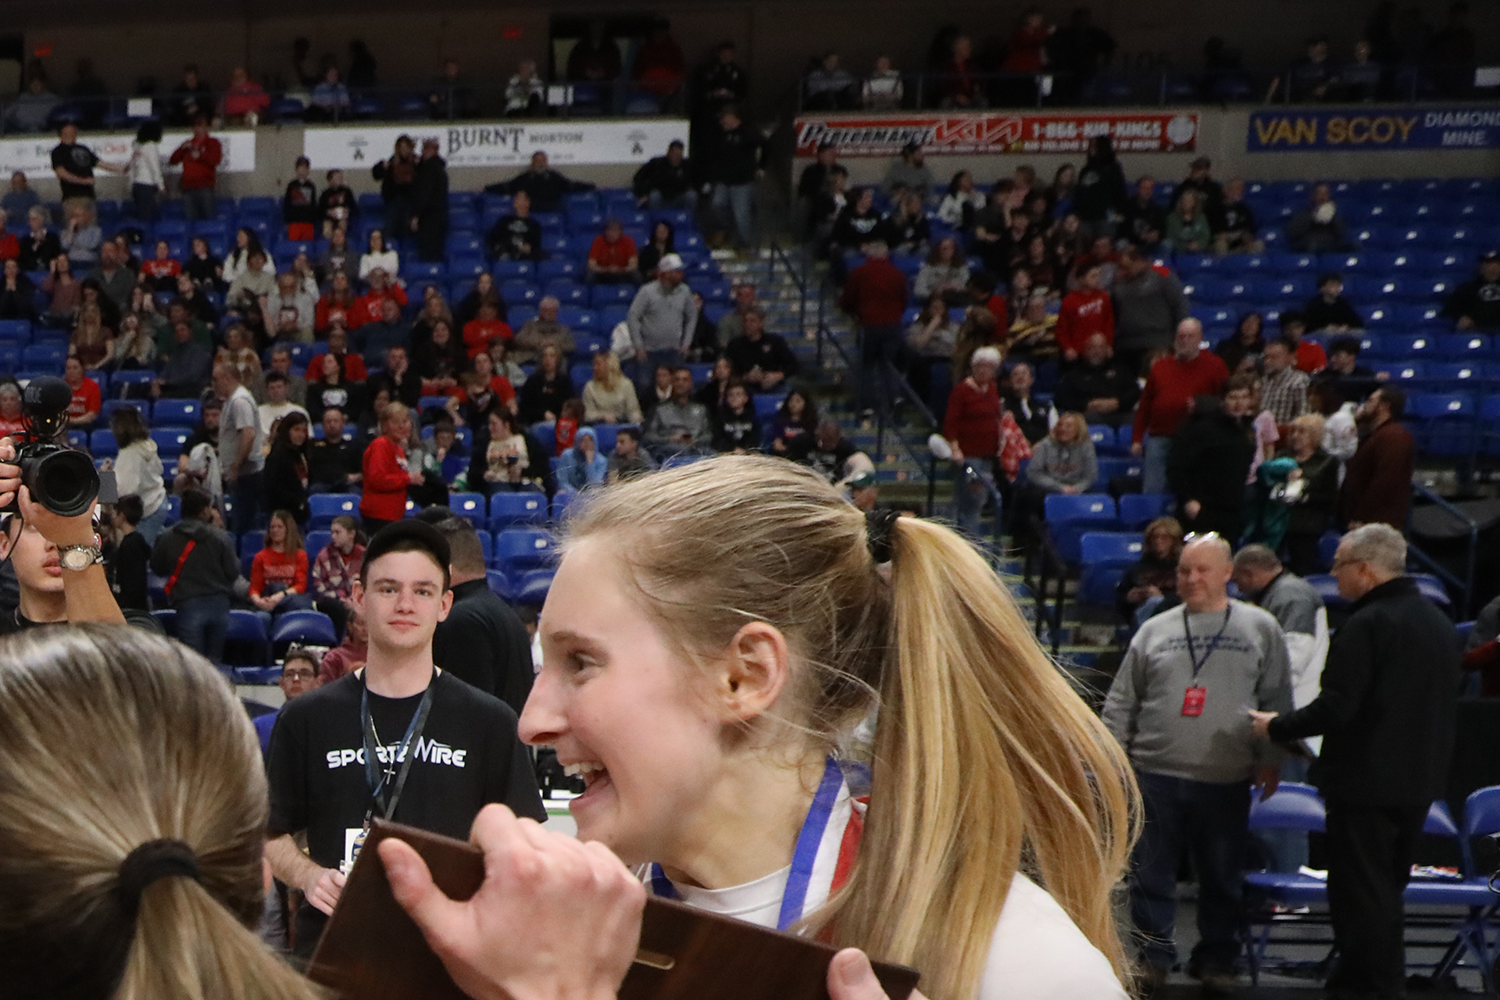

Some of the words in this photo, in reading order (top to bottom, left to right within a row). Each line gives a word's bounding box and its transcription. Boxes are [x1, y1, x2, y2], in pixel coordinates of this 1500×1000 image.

[448, 128, 525, 153] BURNT
[1255, 117, 1318, 145] VAN
[1325, 117, 1420, 144] SCOY
[1441, 130, 1487, 147] MINE
